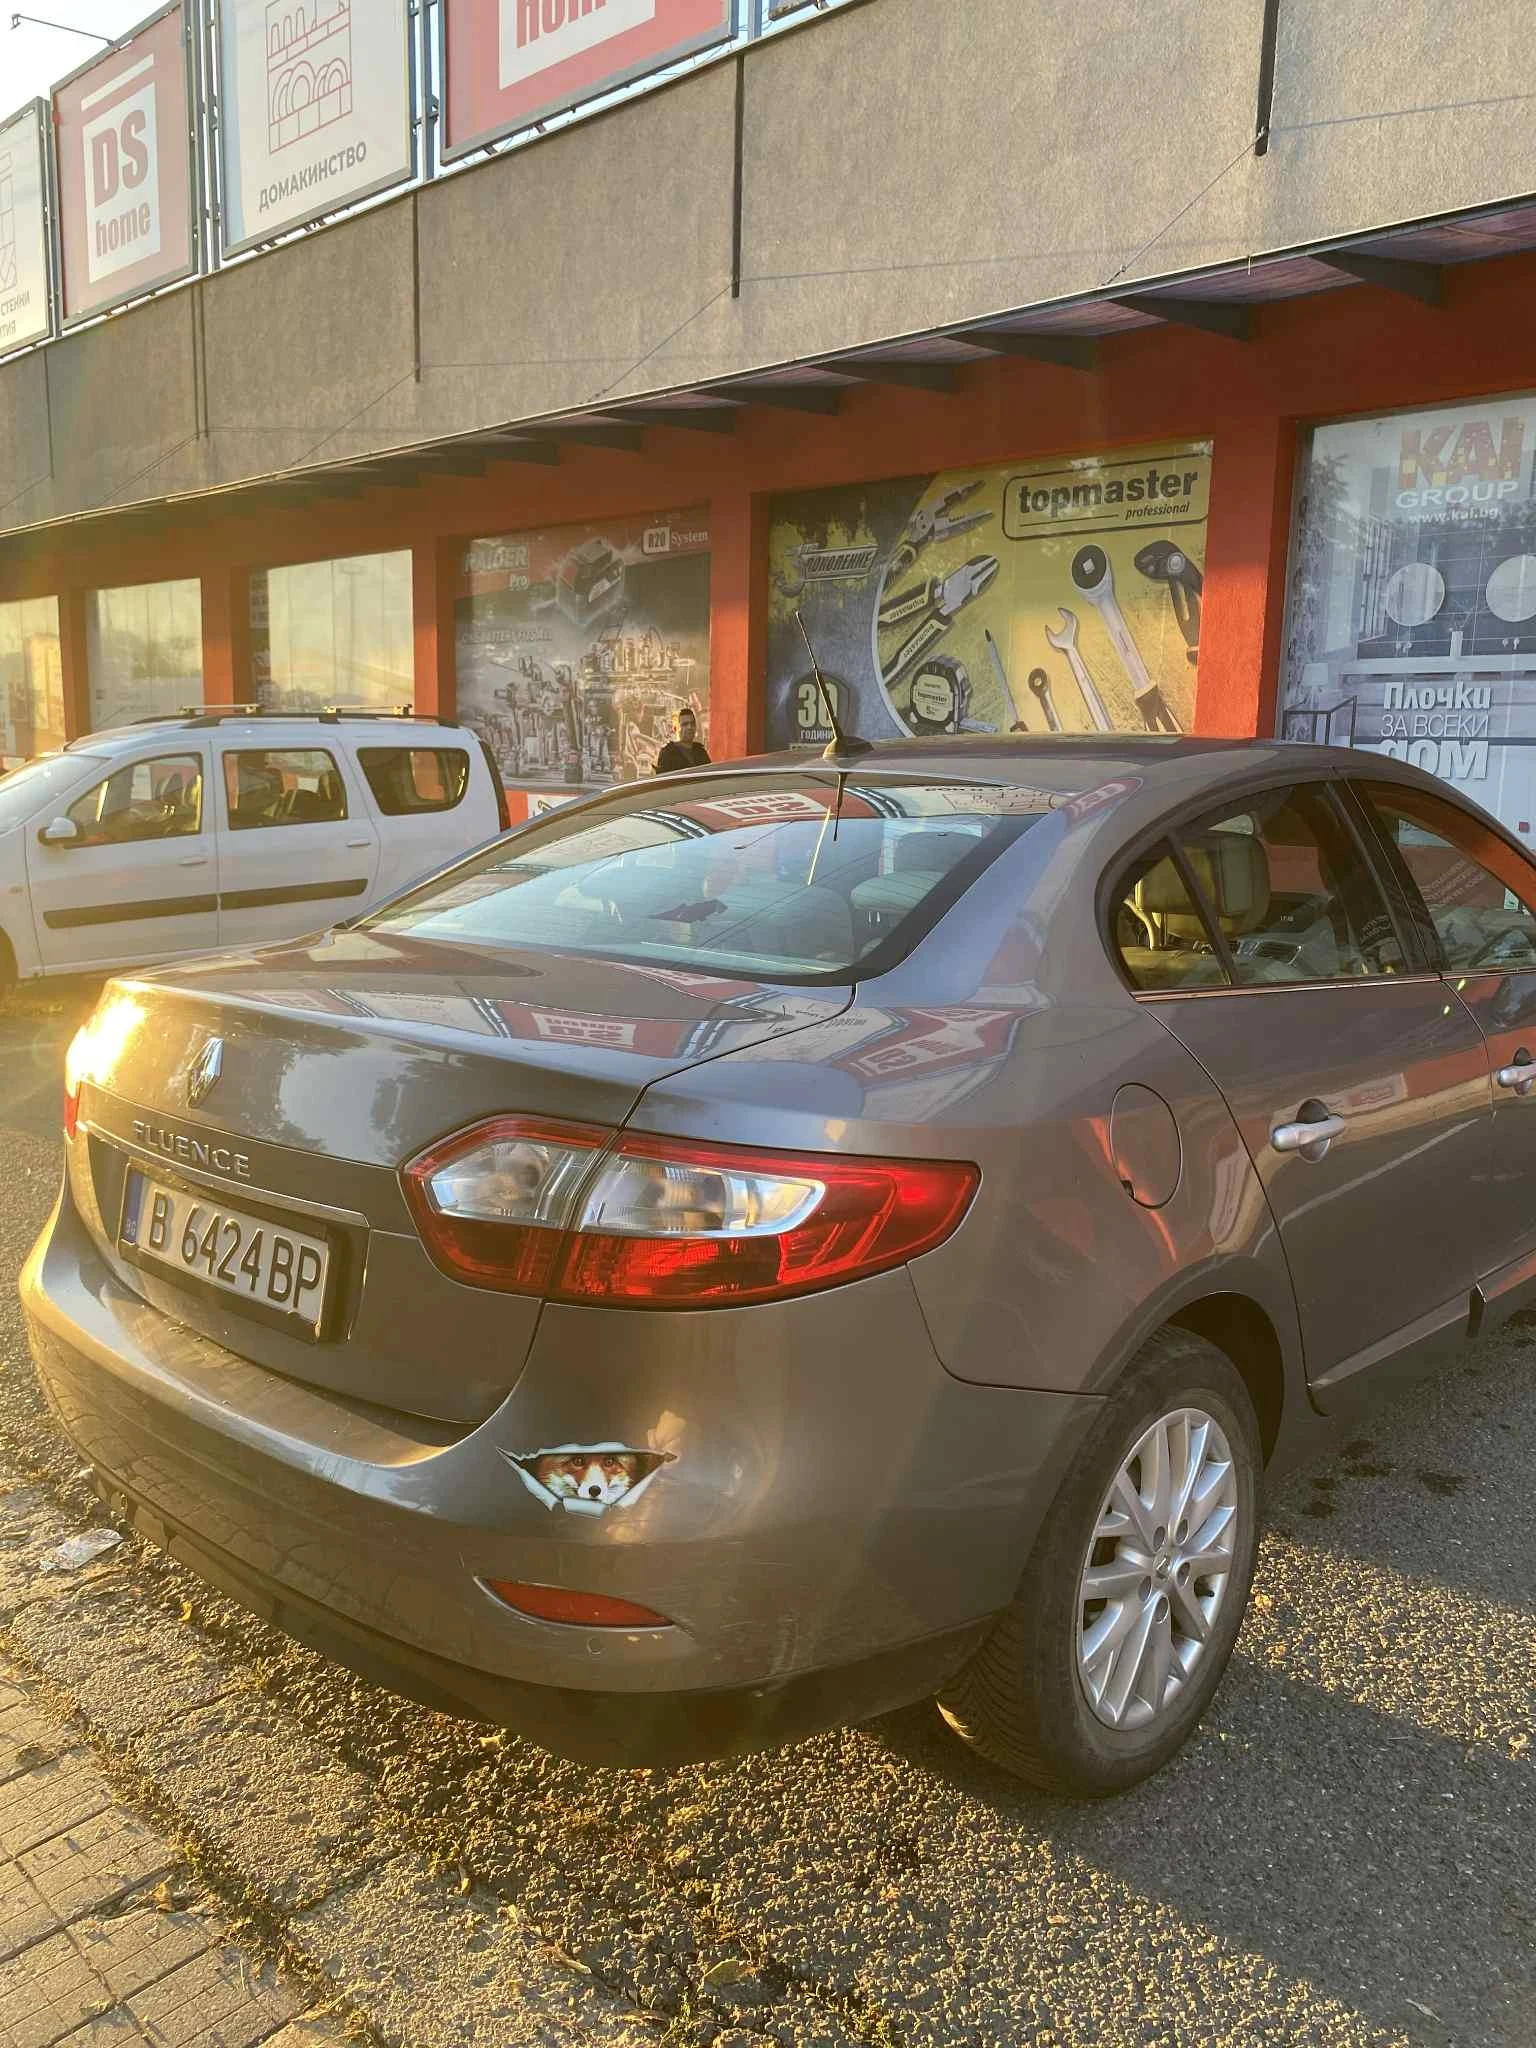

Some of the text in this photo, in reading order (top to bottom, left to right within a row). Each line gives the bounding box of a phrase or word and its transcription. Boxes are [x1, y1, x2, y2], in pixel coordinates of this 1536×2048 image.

[92, 110, 148, 208] DS
[259, 141, 367, 212] ДОМАКИНСТВО
[96, 201, 151, 257] home
[1400, 416, 1524, 488] KAI
[1019, 470, 1198, 518] topmaster
[1125, 502, 1190, 521] professional
[1395, 480, 1519, 509] GROUP
[1408, 506, 1499, 524] www.kai.bg
[671, 529, 709, 548] System
[798, 682, 838, 728] 30
[1383, 680, 1491, 710] Плочки
[1380, 713, 1489, 738] ЗА ВСЕКИ
[132, 1119, 251, 1178] FLUENCE
